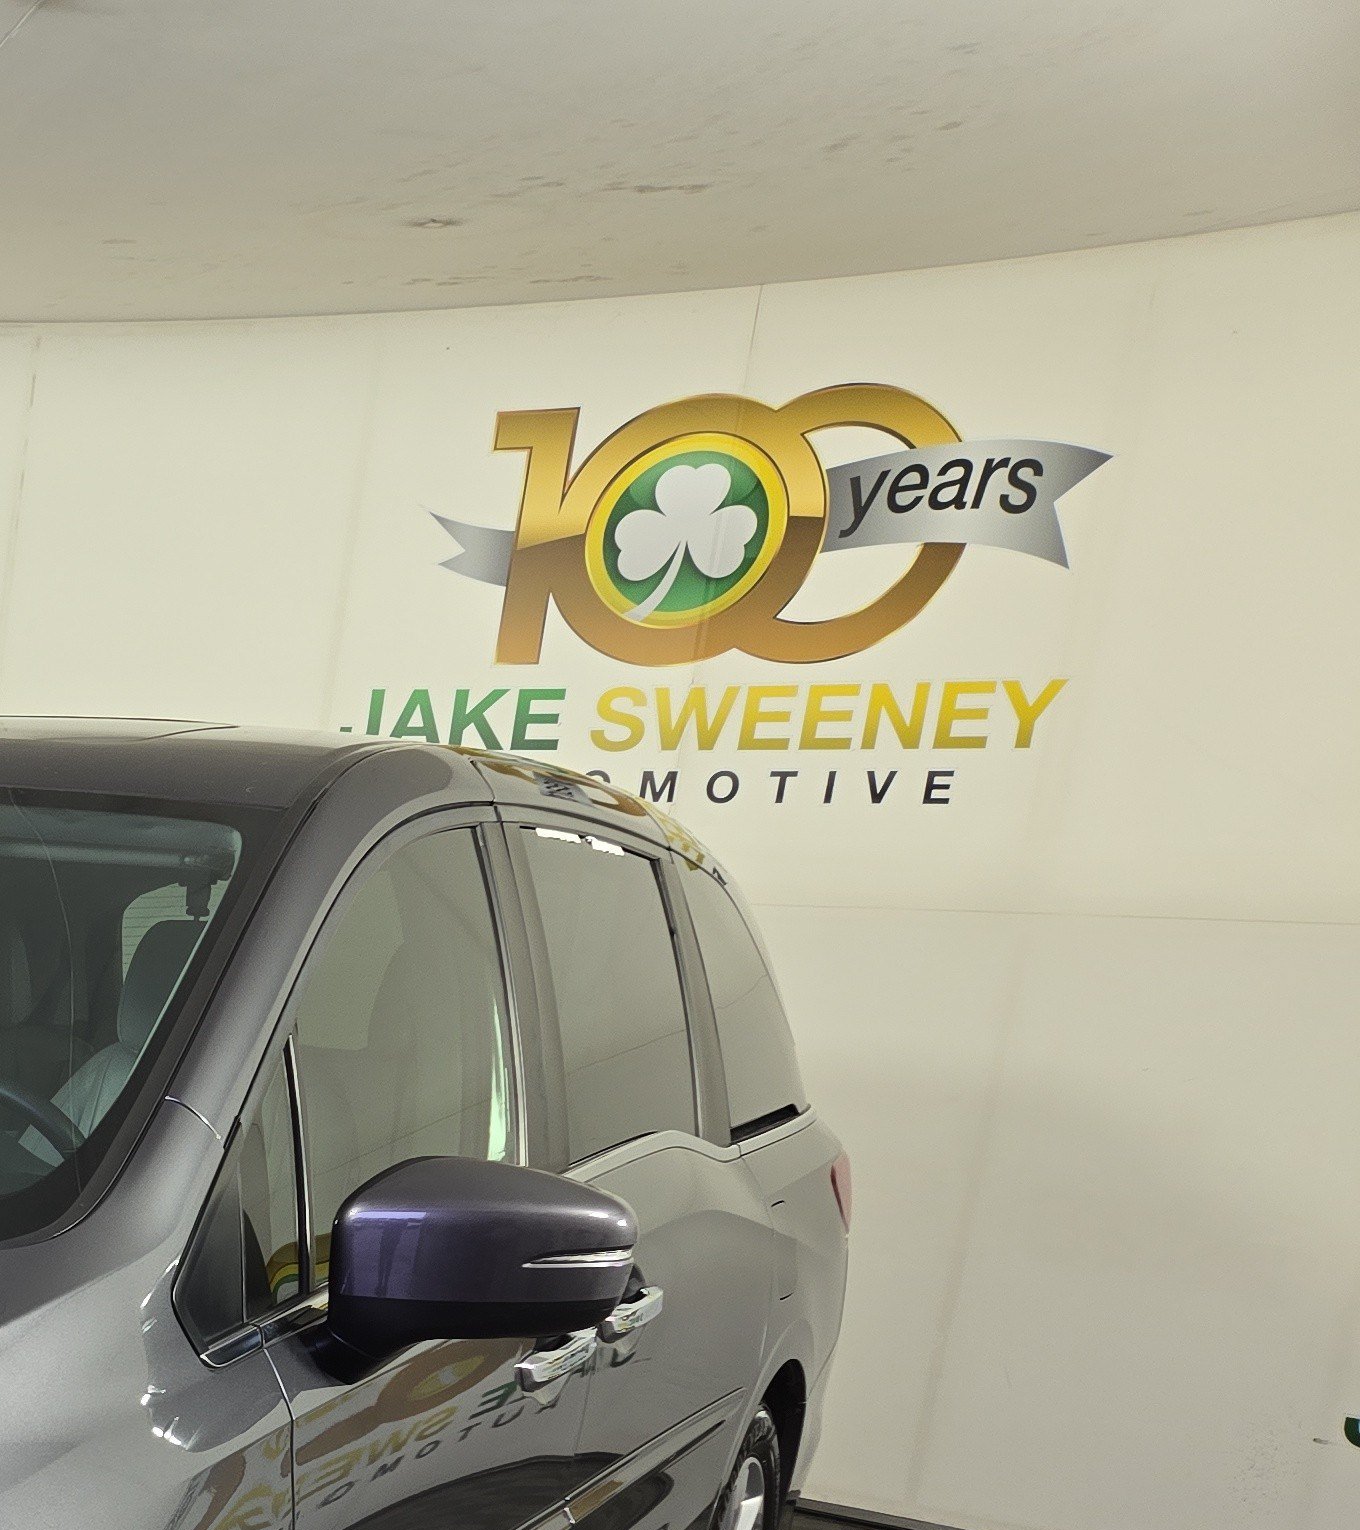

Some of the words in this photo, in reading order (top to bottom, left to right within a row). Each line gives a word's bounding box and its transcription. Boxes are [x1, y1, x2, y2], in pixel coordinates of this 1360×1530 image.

[838, 453, 1045, 540] years
[589, 678, 1069, 754] SWEENEY
[584, 768, 956, 806] MOTIVE
